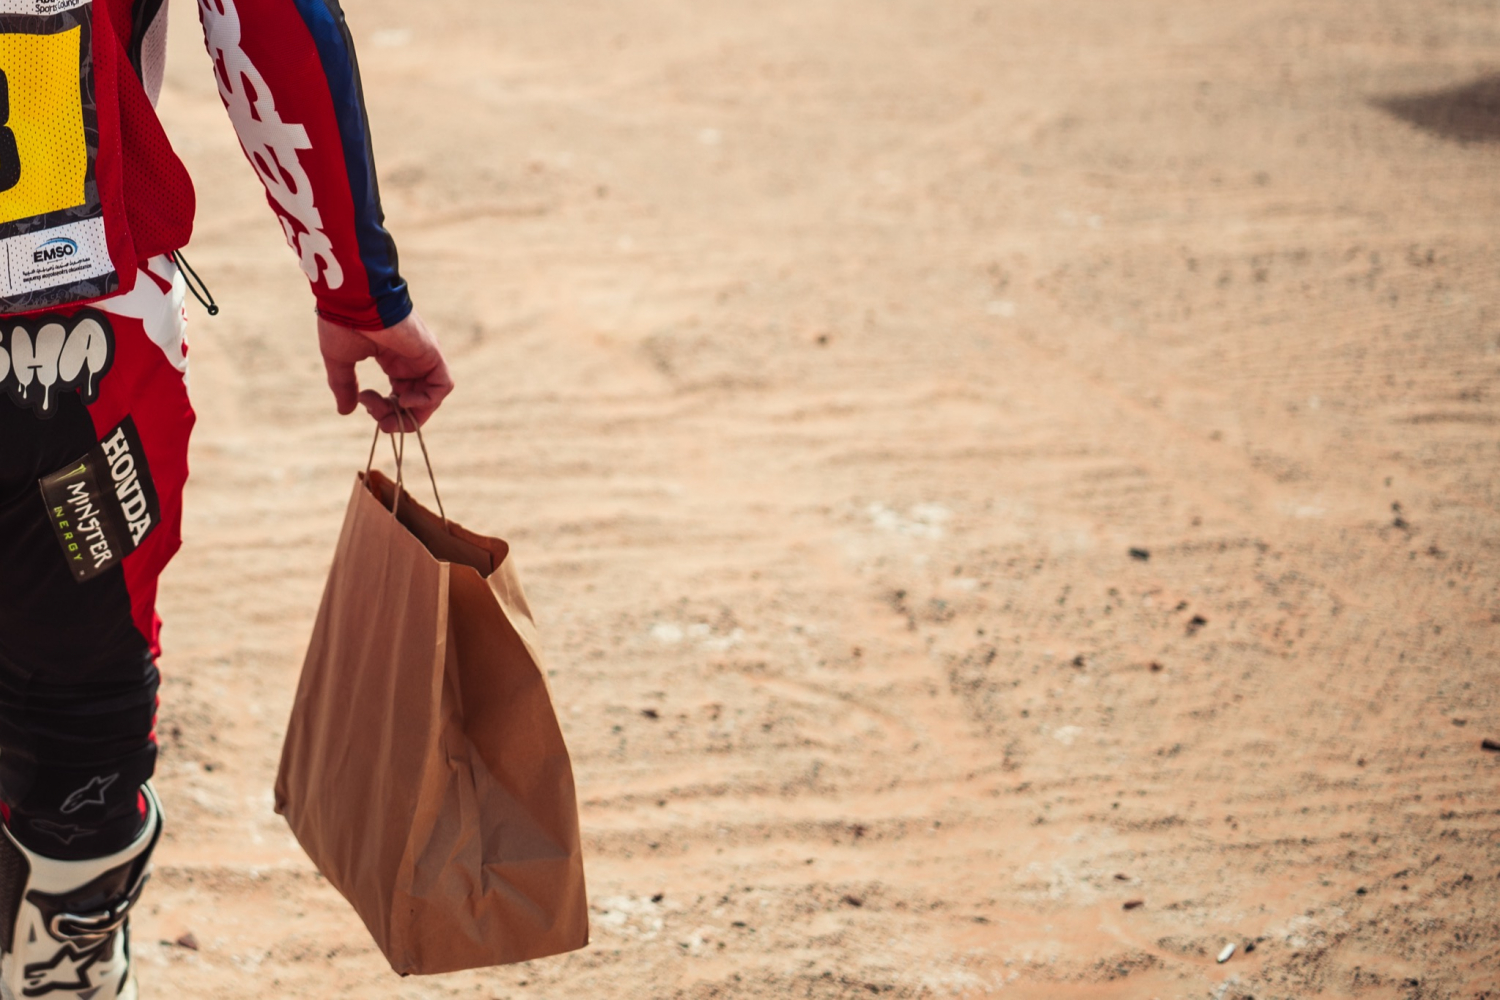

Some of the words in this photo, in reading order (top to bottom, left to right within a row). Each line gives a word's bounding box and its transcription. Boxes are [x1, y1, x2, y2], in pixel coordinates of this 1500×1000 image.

[35, 4, 58, 14] Sports
[33, 244, 73, 263] EMSO
[101, 427, 151, 547] HONDA
